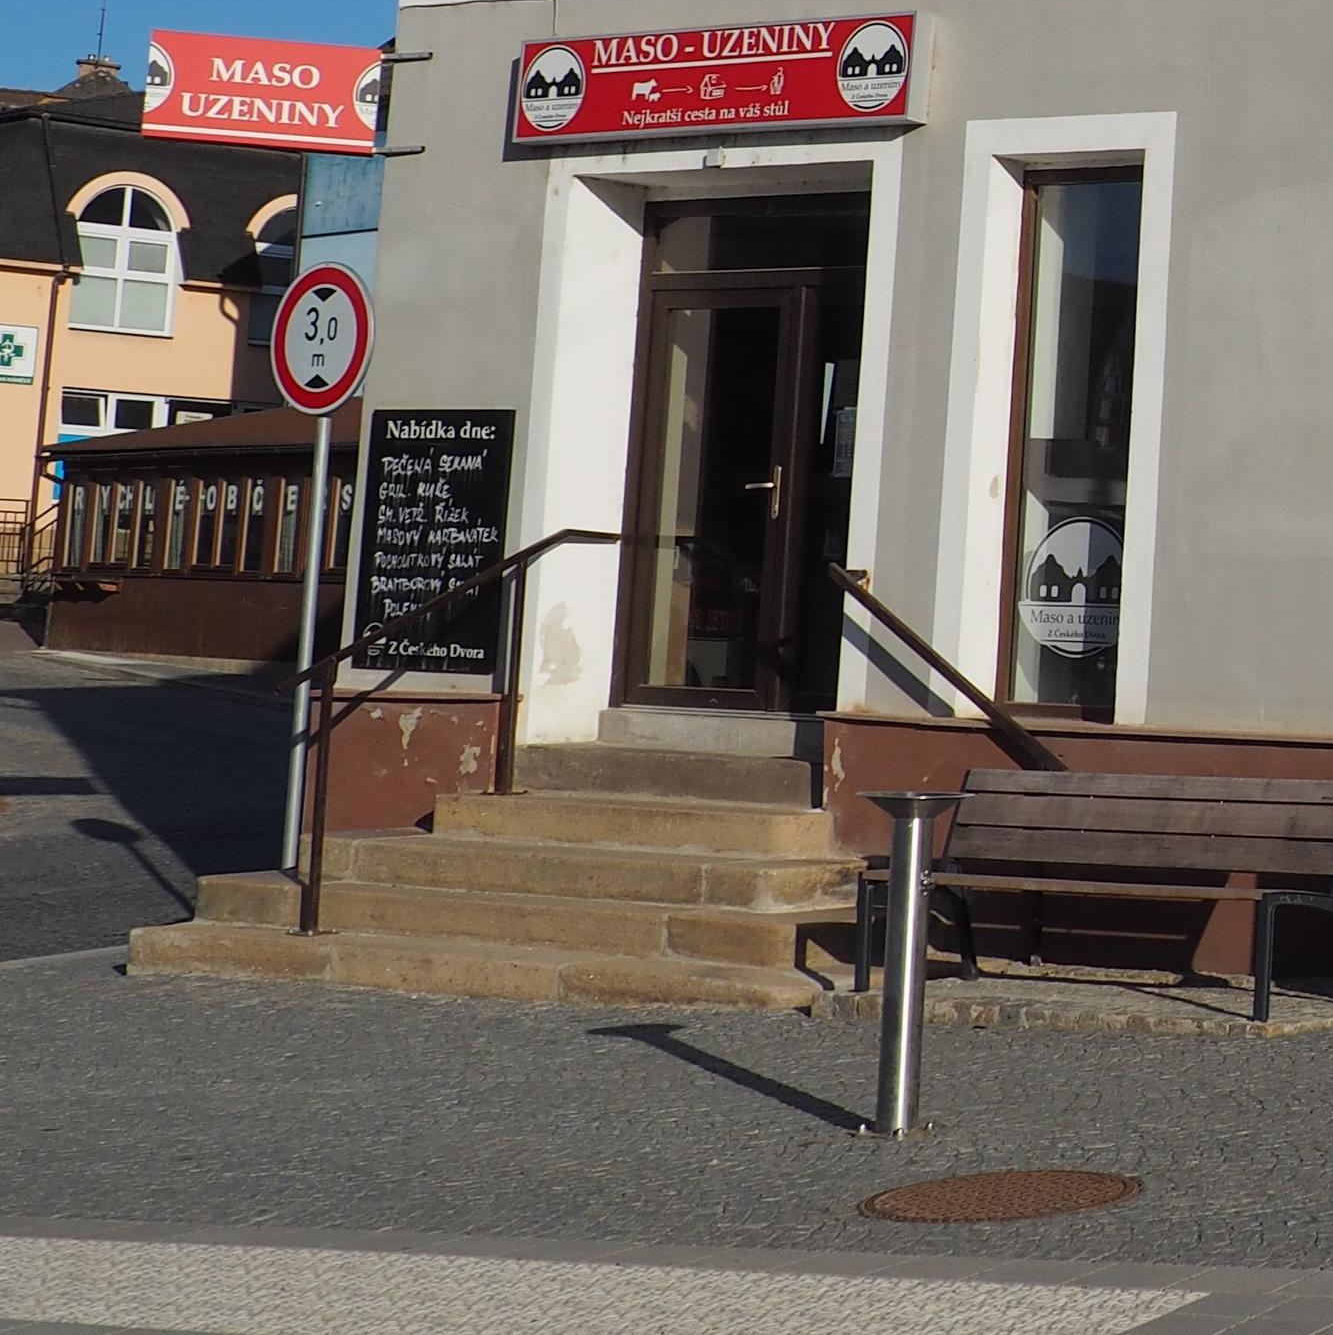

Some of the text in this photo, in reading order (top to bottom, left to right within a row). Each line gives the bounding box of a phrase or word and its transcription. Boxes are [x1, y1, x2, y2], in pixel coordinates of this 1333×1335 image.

[593, 34, 679, 66] MASO
[701, 22, 837, 58] UZENINY
[209, 57, 321, 90] MASO
[180, 91, 346, 128] UZENINY
[622, 100, 790, 129] Nejkratší cesta na váš stůl
[305, 307, 338, 345] 3,0
[311, 353, 325, 367] m
[386, 420, 496, 440] Nabídka dne:
[1030, 609, 1064, 624] Maso
[1067, 615, 1074, 624] a
[388, 641, 398, 655] Z
[450, 643, 485, 659] Dvora
